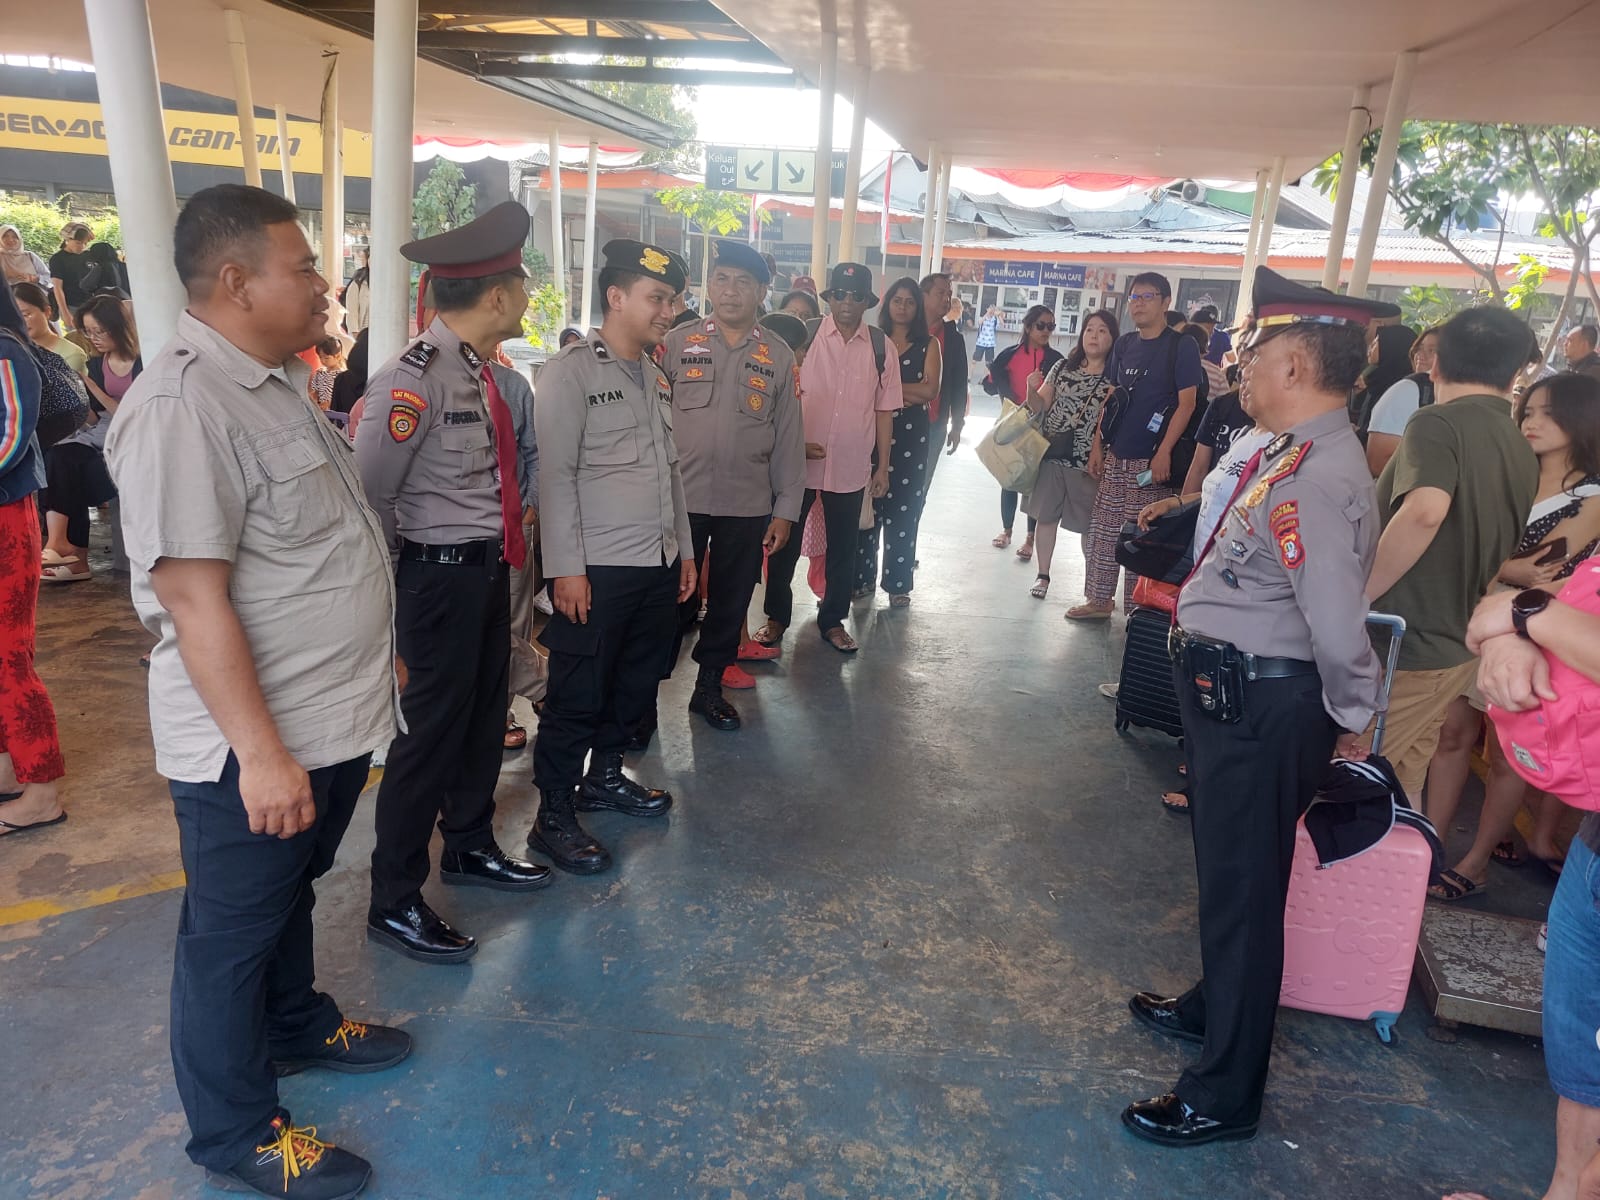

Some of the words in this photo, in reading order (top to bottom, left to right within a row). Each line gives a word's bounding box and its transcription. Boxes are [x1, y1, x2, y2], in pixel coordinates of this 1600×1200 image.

[708, 152, 736, 164] Keluar
[719, 165, 735, 174] Out
[989, 268, 1016, 278] MARINA
[1017, 270, 1035, 279] CAFE
[1044, 271, 1067, 280] MARINA
[1067, 273, 1082, 282] CAFE
[744, 362, 775, 378] POLRI
[588, 389, 624, 406] RYAN
